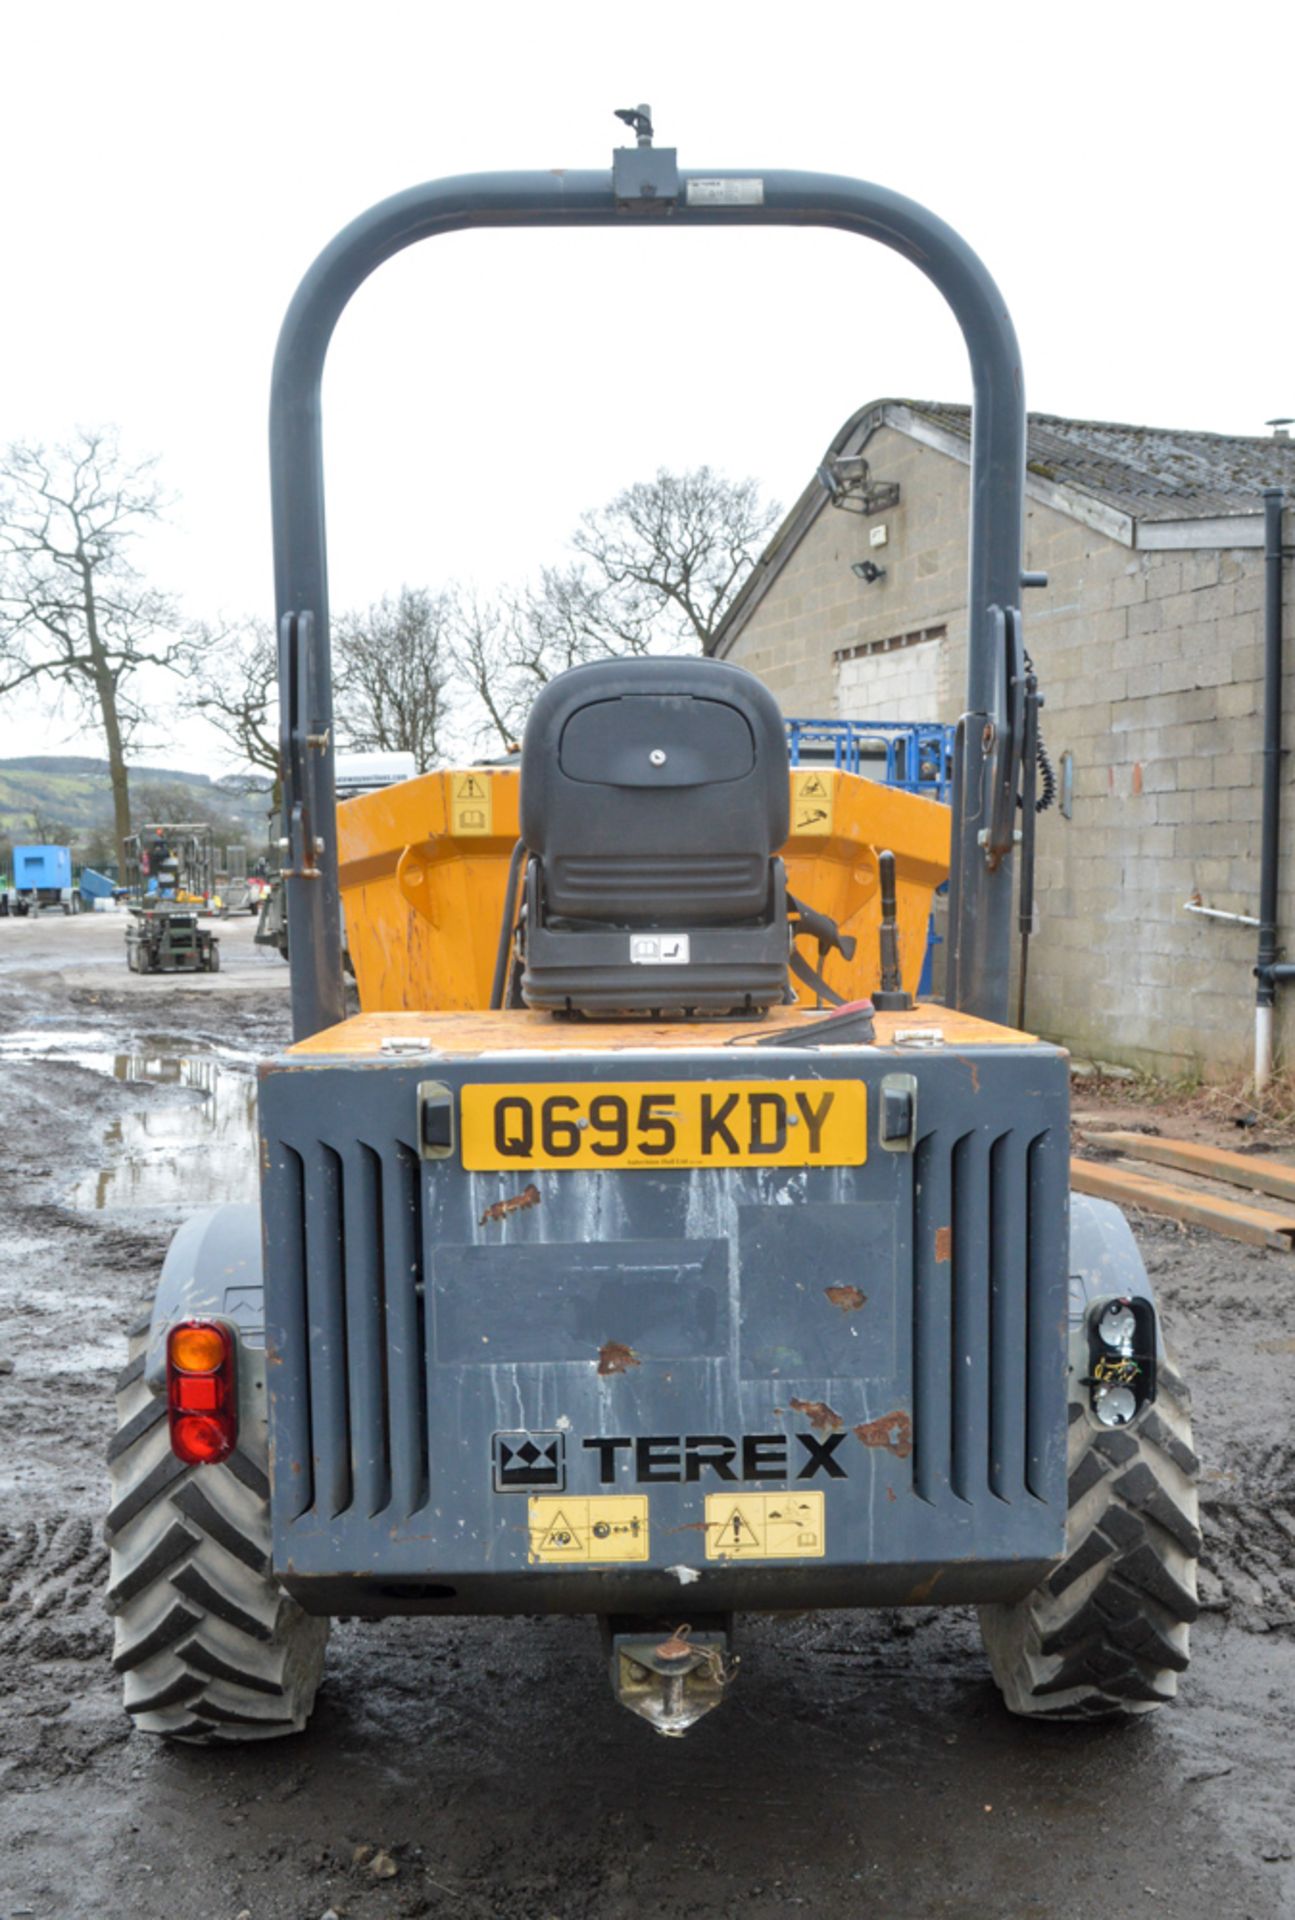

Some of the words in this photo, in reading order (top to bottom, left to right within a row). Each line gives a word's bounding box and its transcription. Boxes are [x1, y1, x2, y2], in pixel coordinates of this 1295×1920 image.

[494, 1094, 676, 1158] Q695
[700, 1092, 835, 1155] KDY
[582, 1433, 848, 1484] TEREX
